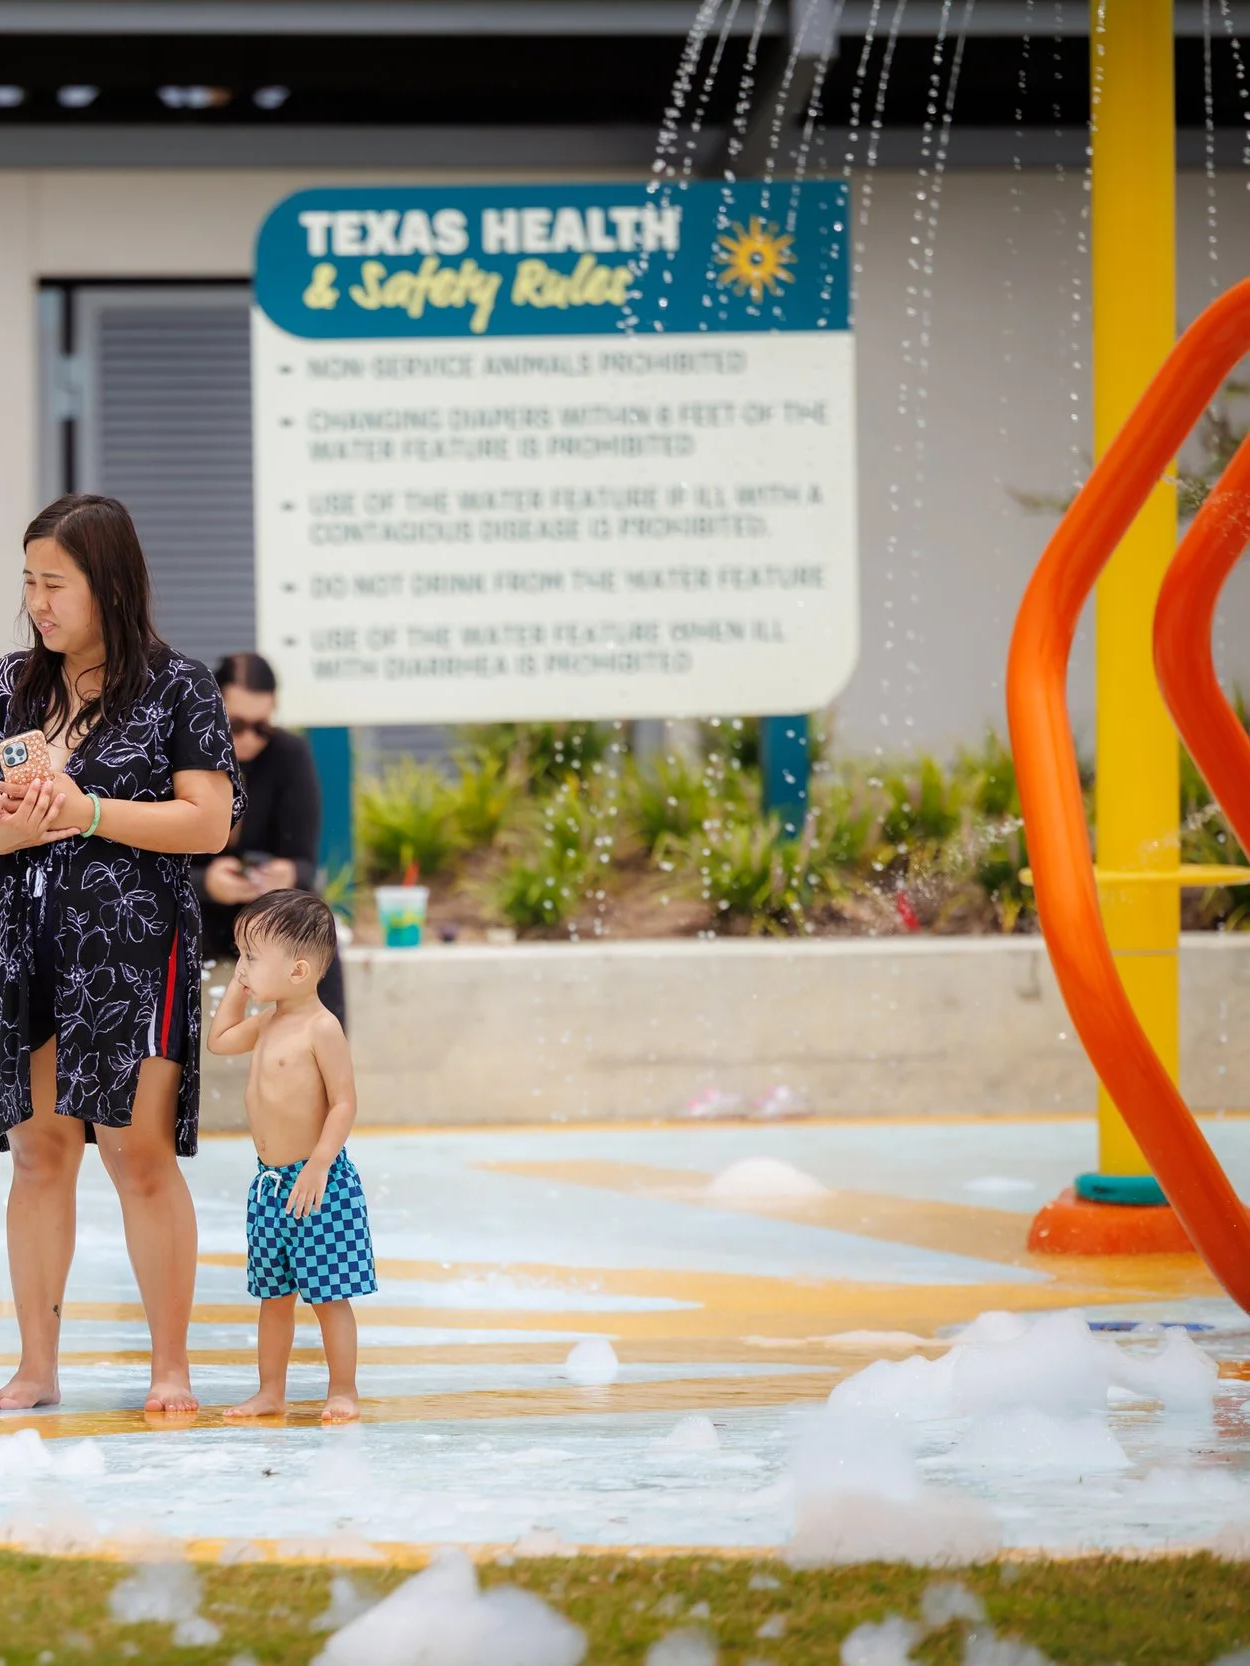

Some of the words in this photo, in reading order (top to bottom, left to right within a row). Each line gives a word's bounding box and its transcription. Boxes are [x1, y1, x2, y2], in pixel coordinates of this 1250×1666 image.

[299, 209, 469, 256] TEXAS
[482, 206, 680, 253] HEALTH
[303, 263, 339, 309] &
[351, 257, 502, 332] Safety
[512, 253, 633, 309] Rules
[483, 353, 591, 376] ANIMALS
[601, 351, 747, 374] PROHIBITED
[307, 408, 441, 432] CHANGING
[449, 406, 552, 430] DIAPERS
[560, 404, 649, 427] WITHIN
[680, 402, 735, 425] FEET
[741, 401, 774, 425] OF
[785, 399, 829, 424] THE
[308, 439, 394, 462] WATER
[402, 437, 509, 460] FEATURE
[519, 436, 541, 459] IS
[547, 434, 697, 458] PROHIBITED
[308, 490, 355, 515] USE
[363, 490, 394, 514] OF
[405, 489, 448, 513] THE
[458, 488, 544, 512] WATER
[551, 486, 657, 510] FEATURE
[666, 486, 686, 507] IF
[695, 485, 725, 508] ILL
[736, 483, 799, 507] WITH
[806, 483, 824, 505] A
[479, 518, 579, 542] DISEASE
[589, 517, 612, 540] IS
[309, 575, 347, 599] DO
[354, 574, 404, 597] NOT
[410, 572, 486, 596] DRINK
[493, 571, 563, 595] FROM
[571, 570, 616, 593] THE
[624, 568, 711, 592] WATER
[717, 565, 826, 590] FEATURE
[310, 627, 358, 652] USE
[366, 626, 398, 650] OF
[407, 625, 451, 650] THE
[460, 623, 546, 648] WATER
[552, 621, 659, 645] FEATURE
[668, 620, 744, 642] WHEN
[751, 619, 785, 643] ILL
[310, 658, 379, 682] WITH
[516, 654, 538, 678] IS
[546, 651, 692, 676] PROHIBITED
